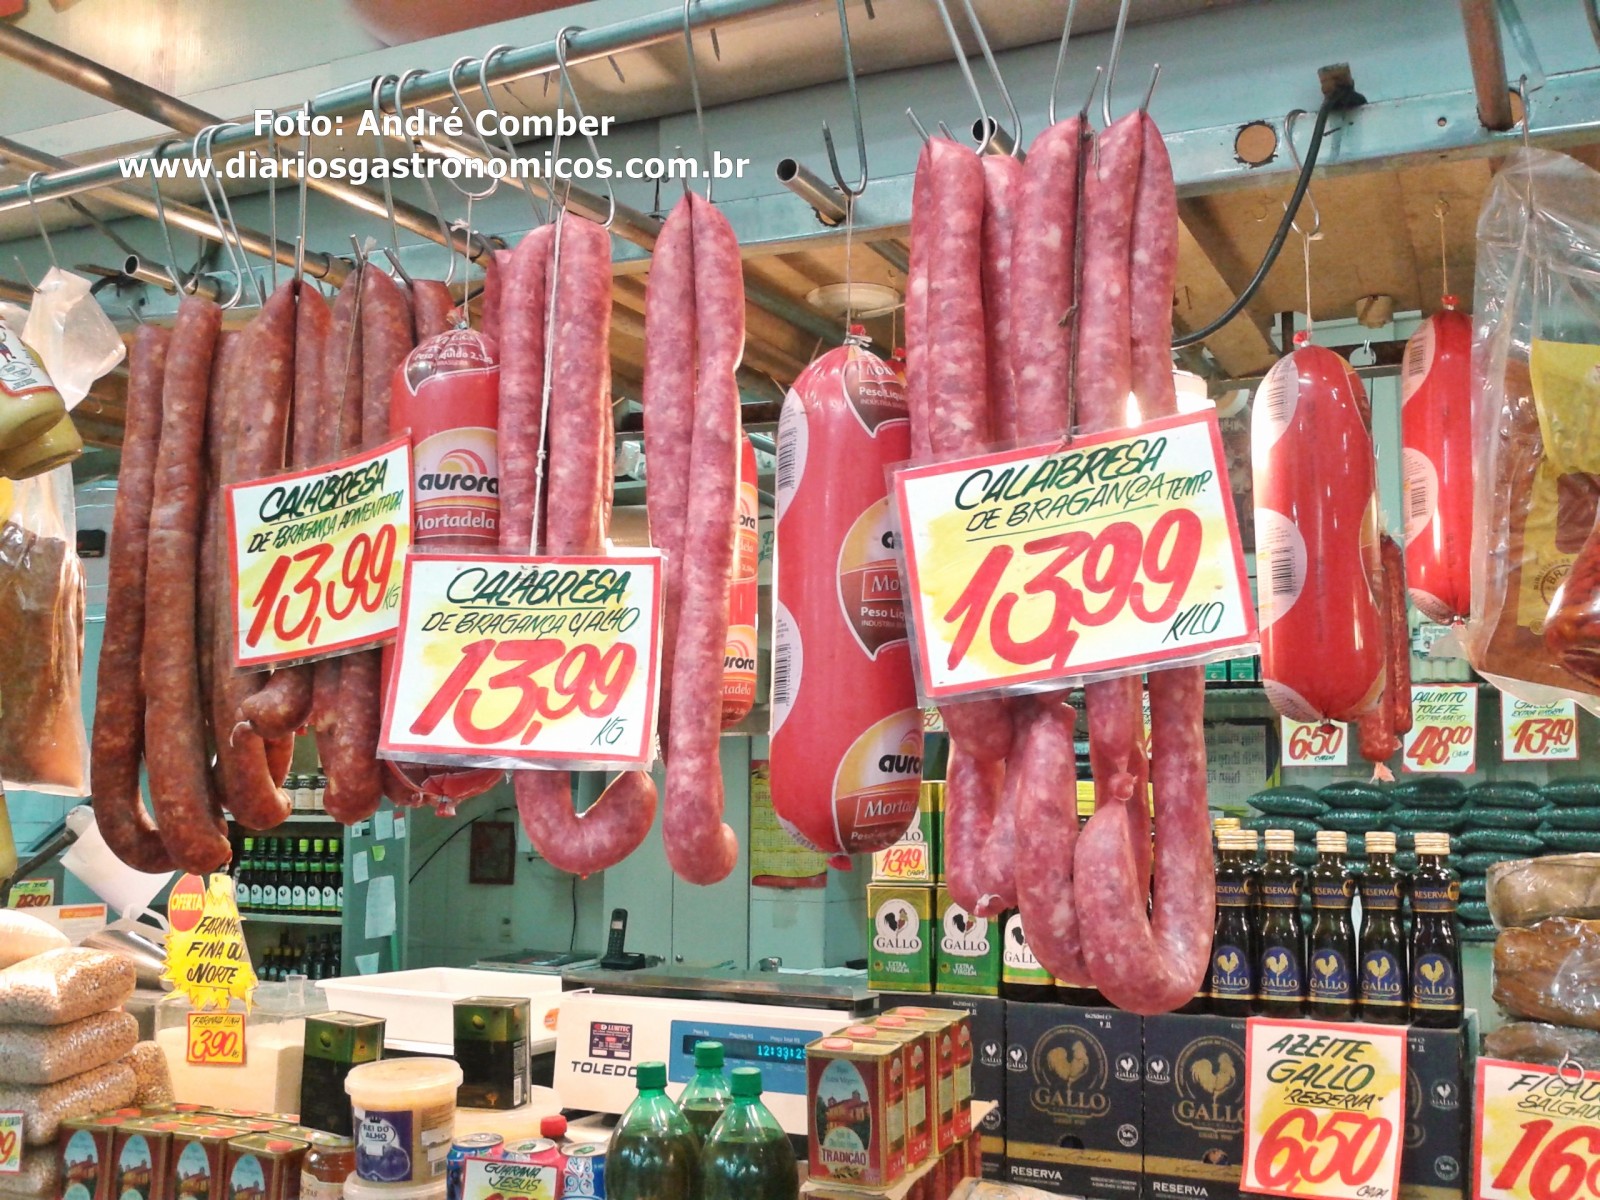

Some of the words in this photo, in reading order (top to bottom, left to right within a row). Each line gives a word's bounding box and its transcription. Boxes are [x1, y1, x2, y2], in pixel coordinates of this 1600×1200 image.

[417, 473, 499, 495] aurora
[954, 436, 1168, 511] CALABRESA
[259, 458, 389, 523] CALABRESA
[966, 507, 1003, 532] DE
[1005, 475, 1166, 527] BRAGANÇA
[247, 530, 274, 554] DE
[272, 514, 338, 550] BRAGANÇA
[246, 523, 397, 648] 13,99
[382, 584, 402, 611] KG
[446, 567, 632, 606] CALABRESA
[943, 507, 1203, 672] 13,99
[1162, 601, 1225, 644] KILO
[860, 606, 888, 618] Peso
[421, 611, 456, 632] DE
[454, 614, 567, 641] BRAGANÇA
[409, 638, 637, 746] 13,99
[590, 716, 628, 746] KG
[1411, 691, 1468, 703] PALMITO
[1416, 704, 1464, 714] TOLETE
[1289, 725, 1344, 761] 6,50
[1405, 725, 1473, 766] 48,00
[1513, 718, 1574, 755] 13,49
[882, 848, 922, 876] 13,49
[171, 892, 204, 912] OFERTA
[1414, 889, 1449, 899] RESERVA
[186, 941, 223, 959] FINA
[876, 937, 920, 949] GALLO
[943, 938, 988, 952] GALLO
[1004, 950, 1041, 964] GALL
[186, 961, 240, 985] NORTE
[1212, 975, 1249, 987] GALLO
[1261, 976, 1298, 988] GALLO
[1309, 977, 1348, 991] GALLO
[1362, 979, 1400, 993] GALLO
[1413, 984, 1455, 997] GALLO
[191, 1029, 238, 1064] 3,90
[1267, 1033, 1373, 1063] AZEITE
[570, 1060, 638, 1078] TOLEDO
[1266, 1059, 1376, 1093] GALLO
[1035, 1087, 1106, 1111] GALLO
[1508, 1074, 1600, 1102] FIGAD
[1254, 1107, 1393, 1194] 6,50
[488, 1175, 542, 1192] JESUS
[1010, 1165, 1063, 1182] RESERVA
[1152, 1181, 1209, 1198] RESERVA
